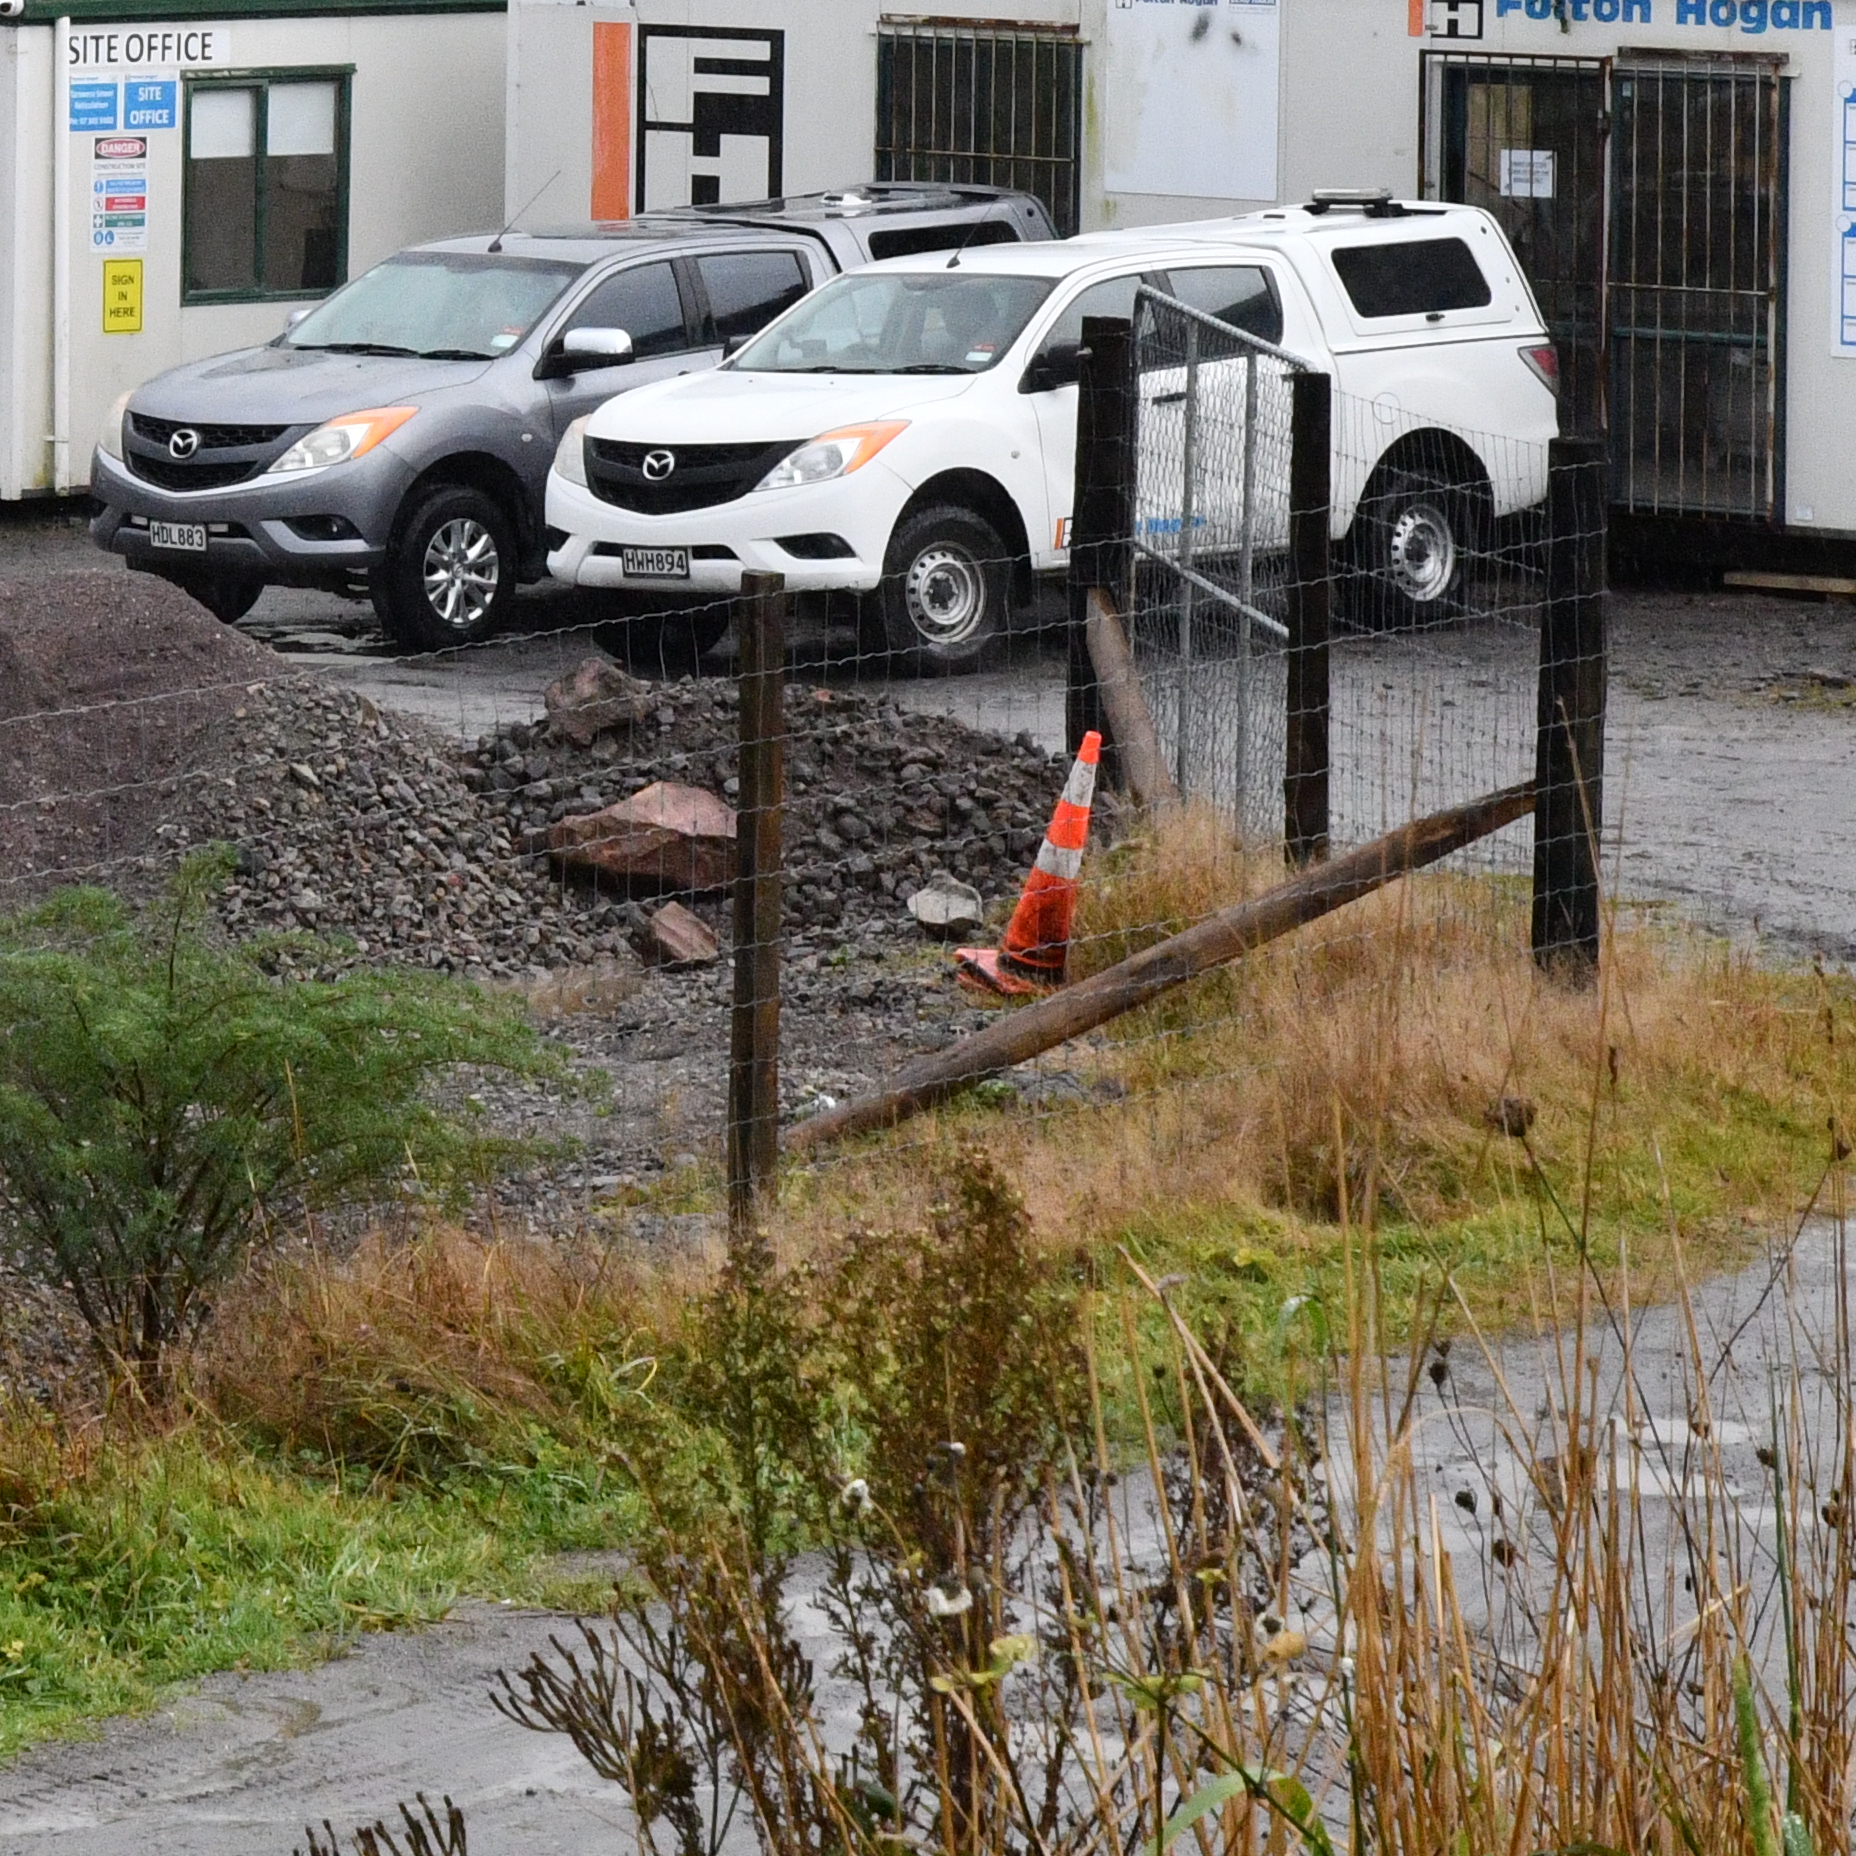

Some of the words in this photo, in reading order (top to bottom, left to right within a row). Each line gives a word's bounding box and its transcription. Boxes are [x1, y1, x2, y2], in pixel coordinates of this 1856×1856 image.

[69, 34, 119, 64] SITE
[125, 32, 213, 63] OFFICE
[138, 86, 162, 101] SITE
[129, 109, 170, 125] OFFICE
[101, 143, 141, 154] DANGER
[111, 275, 135, 286] SIGN
[117, 291, 128, 301] IN
[109, 307, 136, 318] HERE
[152, 524, 204, 548] HDL883
[625, 551, 685, 573] HWH894
